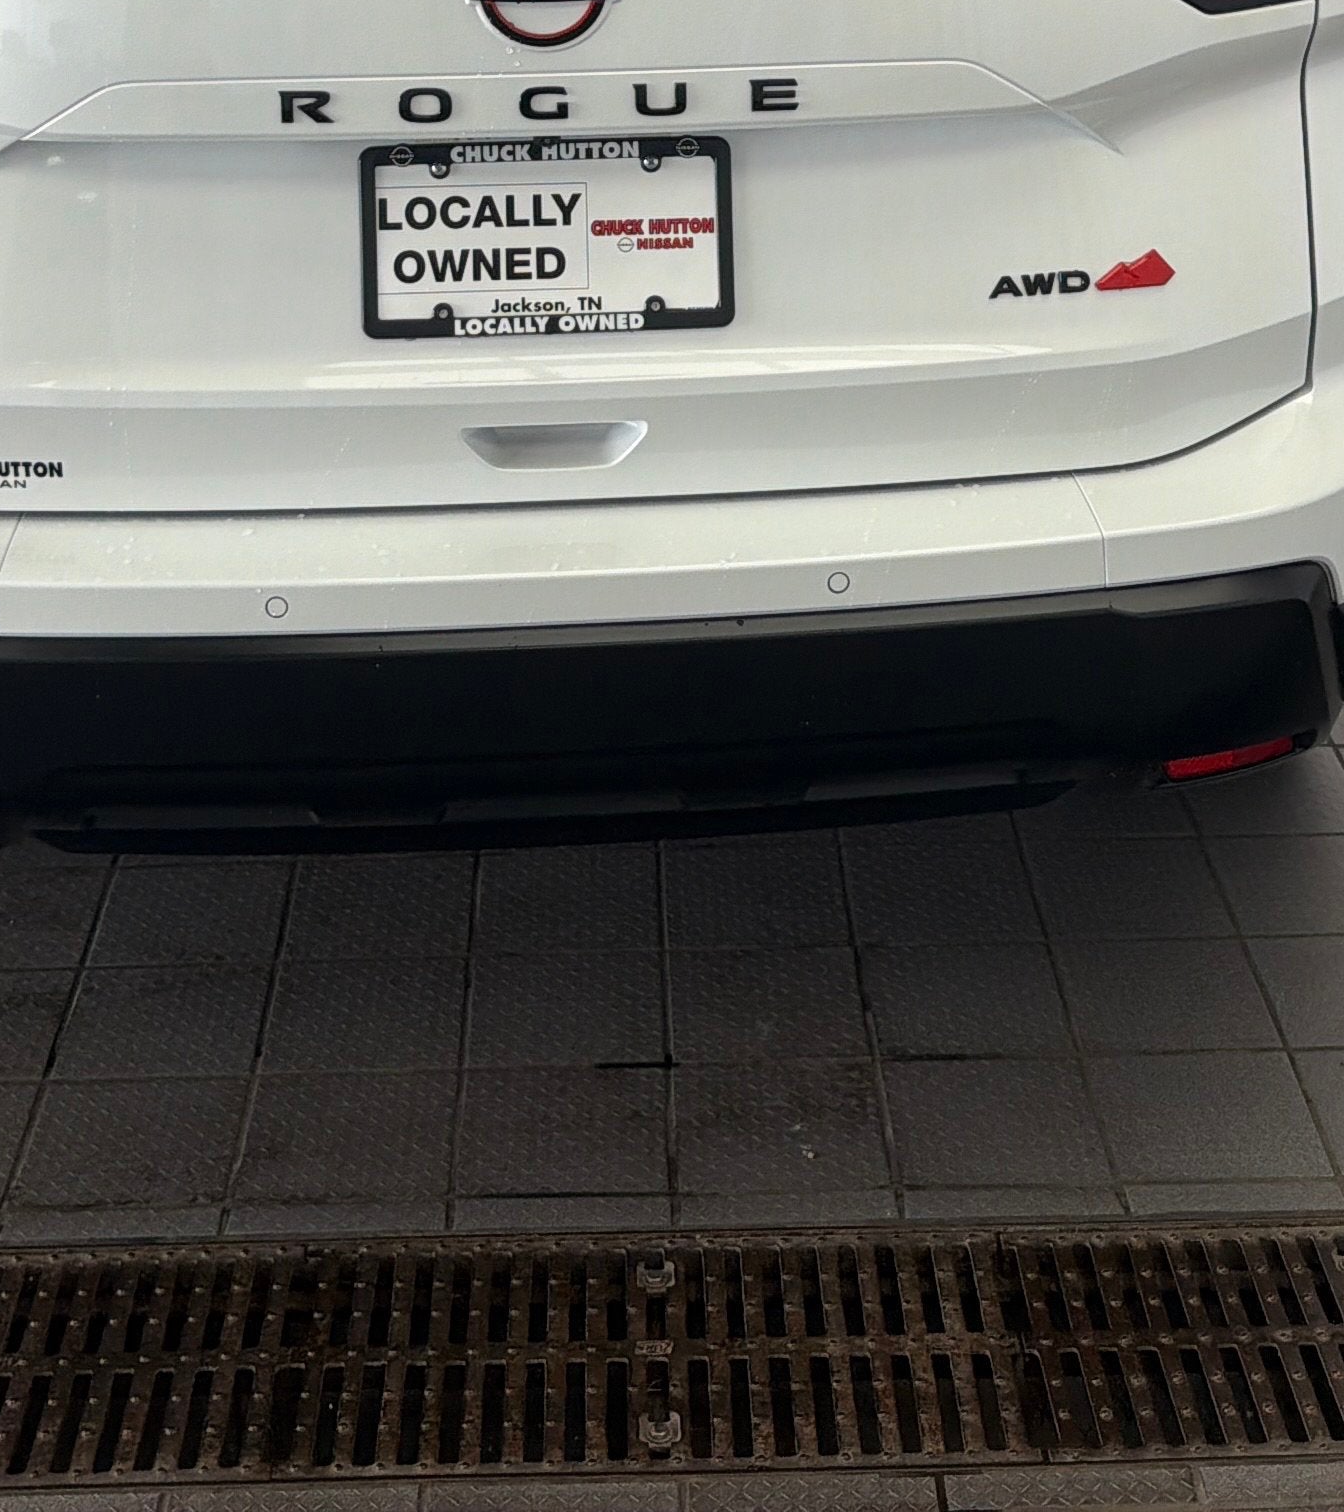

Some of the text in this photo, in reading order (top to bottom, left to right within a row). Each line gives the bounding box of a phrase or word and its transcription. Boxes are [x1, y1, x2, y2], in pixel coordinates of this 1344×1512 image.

[279, 79, 799, 124] ROGUE
[450, 141, 639, 162] CHUCK HUTTON
[379, 193, 582, 230] LOCALLY
[591, 217, 715, 236] CHUCK HUTTON
[637, 237, 694, 250] NISSAN
[394, 247, 566, 284] OWNED
[988, 270, 1090, 299] AWD
[491, 296, 602, 314] Jackson, TN
[454, 313, 645, 336] LOCALLY OWNED
